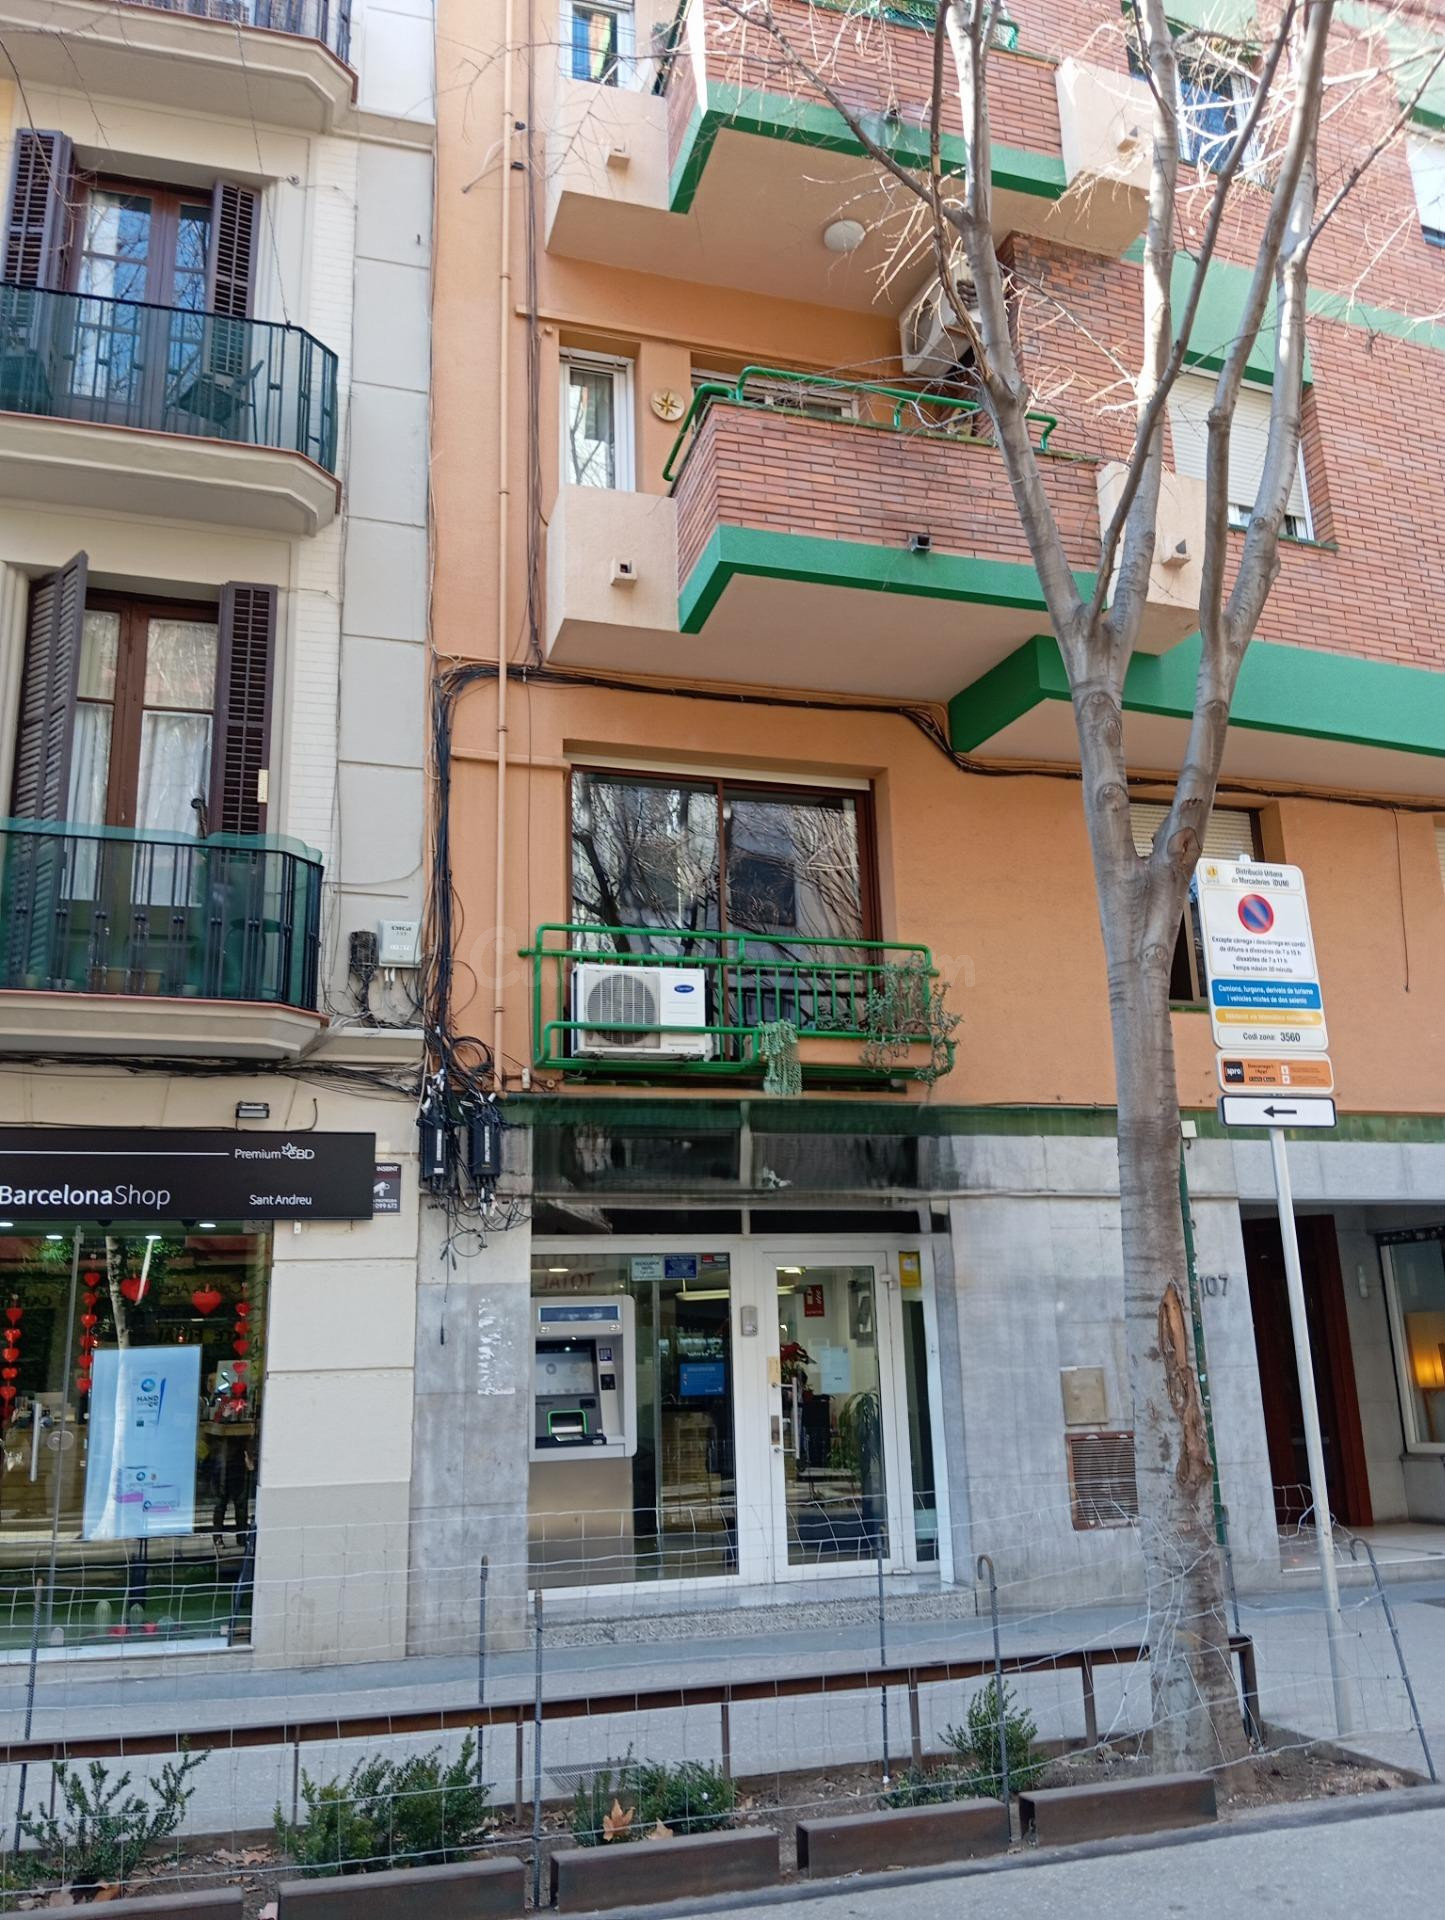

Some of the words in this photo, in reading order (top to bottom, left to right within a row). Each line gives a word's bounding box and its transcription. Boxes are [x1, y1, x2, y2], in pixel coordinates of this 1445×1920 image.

[1243, 1032, 1258, 1040] Codi
[234, 1148, 281, 1159] Premium
[287, 1148, 315, 1159] CBD
[249, 1194, 274, 1206] Sant
[275, 1194, 312, 1206] Andreu
[1200, 1274, 1229, 1297] 107
